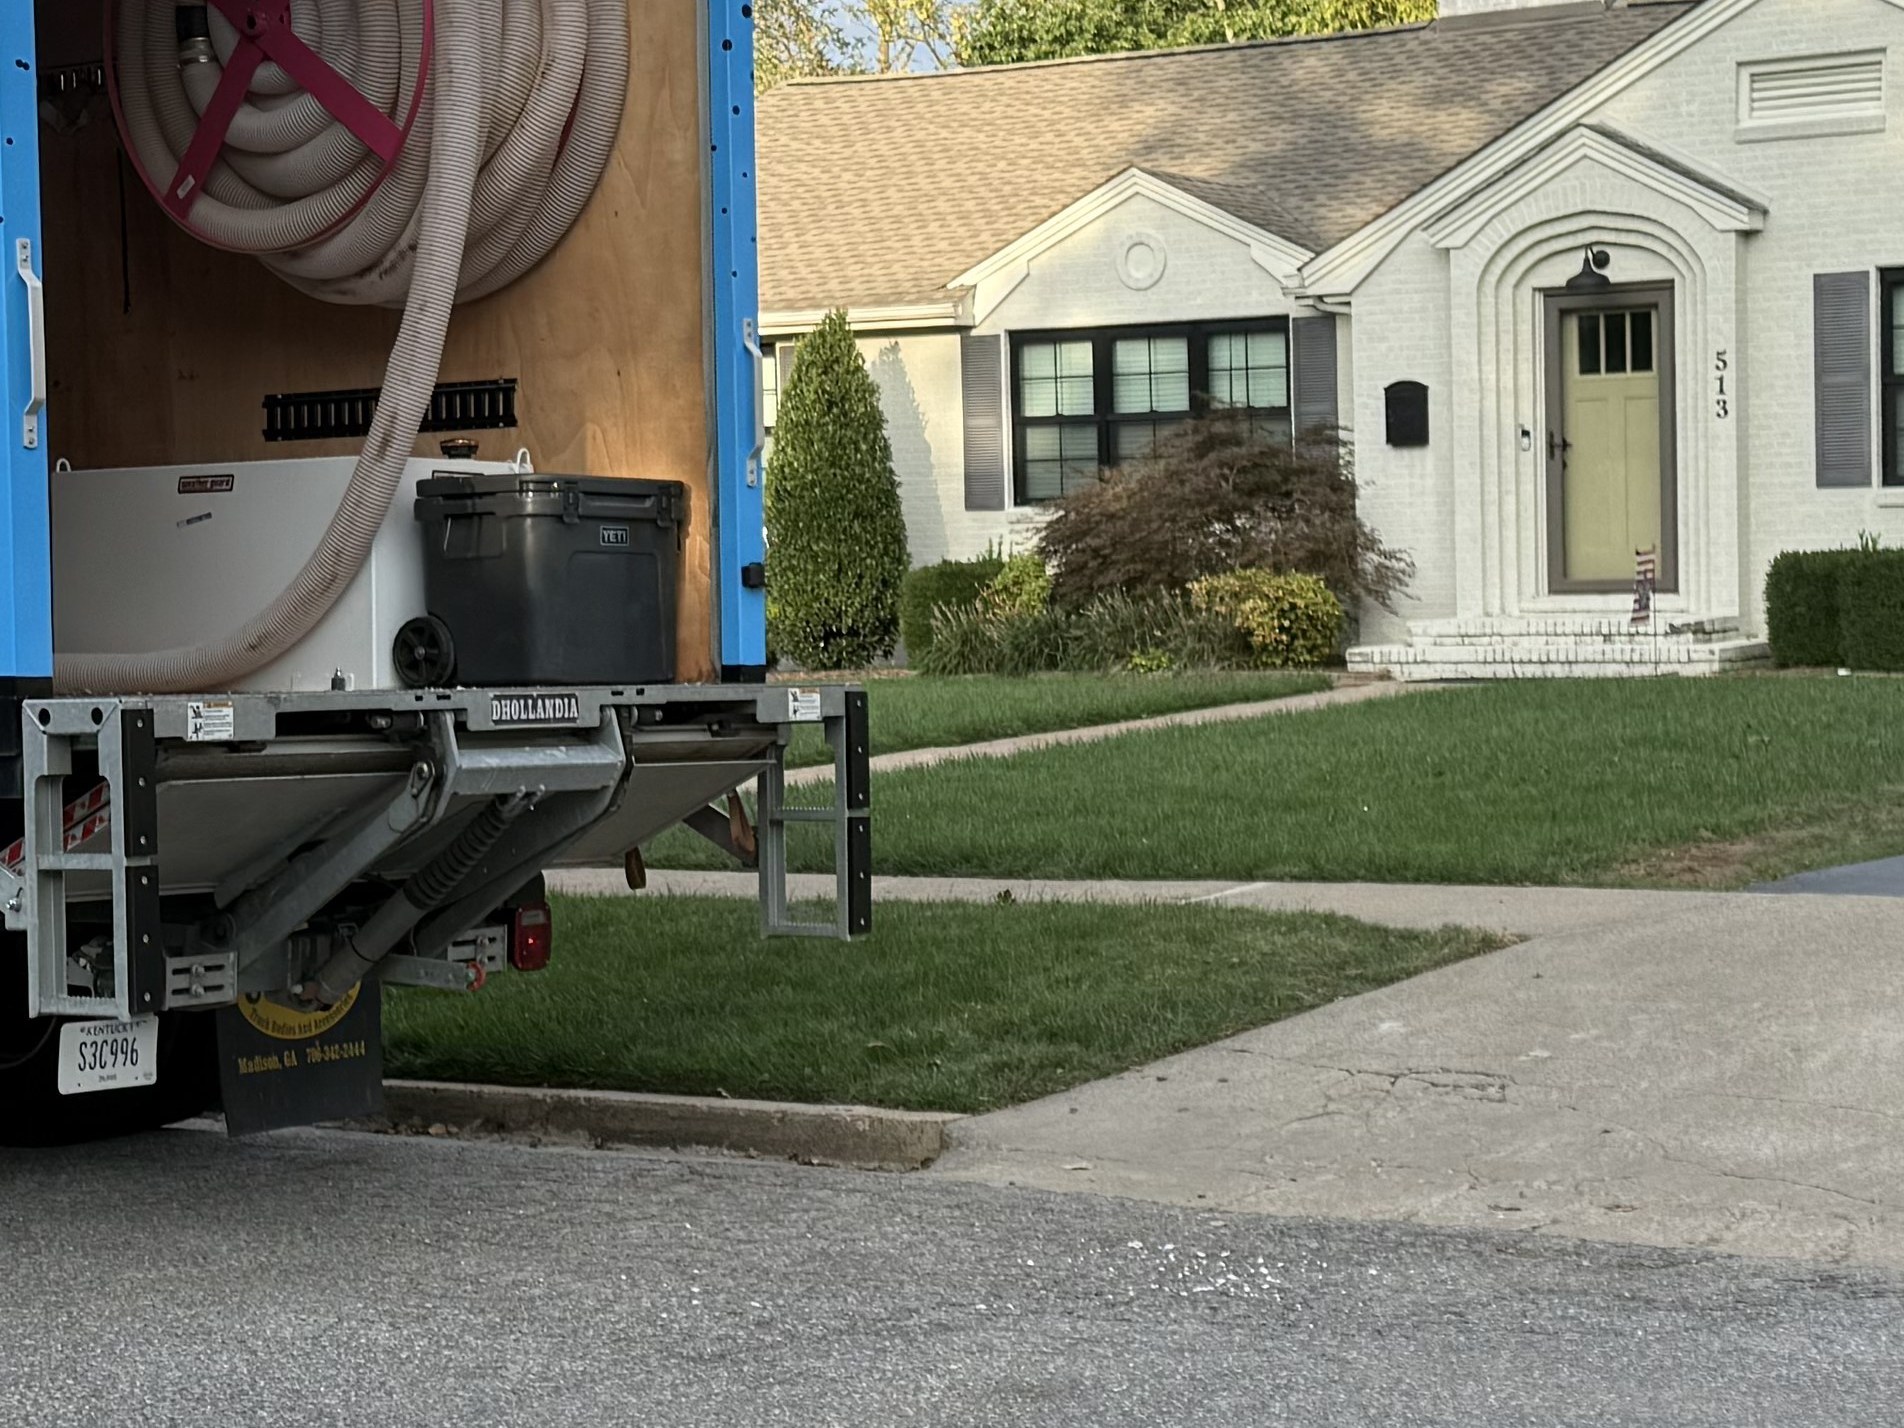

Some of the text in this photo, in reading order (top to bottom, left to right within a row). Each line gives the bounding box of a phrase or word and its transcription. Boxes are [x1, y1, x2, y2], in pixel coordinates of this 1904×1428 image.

[1714, 348, 1729, 419] 513
[602, 530, 626, 542] YETI
[491, 697, 579, 721] DHOLLANDIA
[78, 1037, 139, 1072] S3C996
[238, 1053, 283, 1075] Madison,
[284, 1049, 298, 1068] GA
